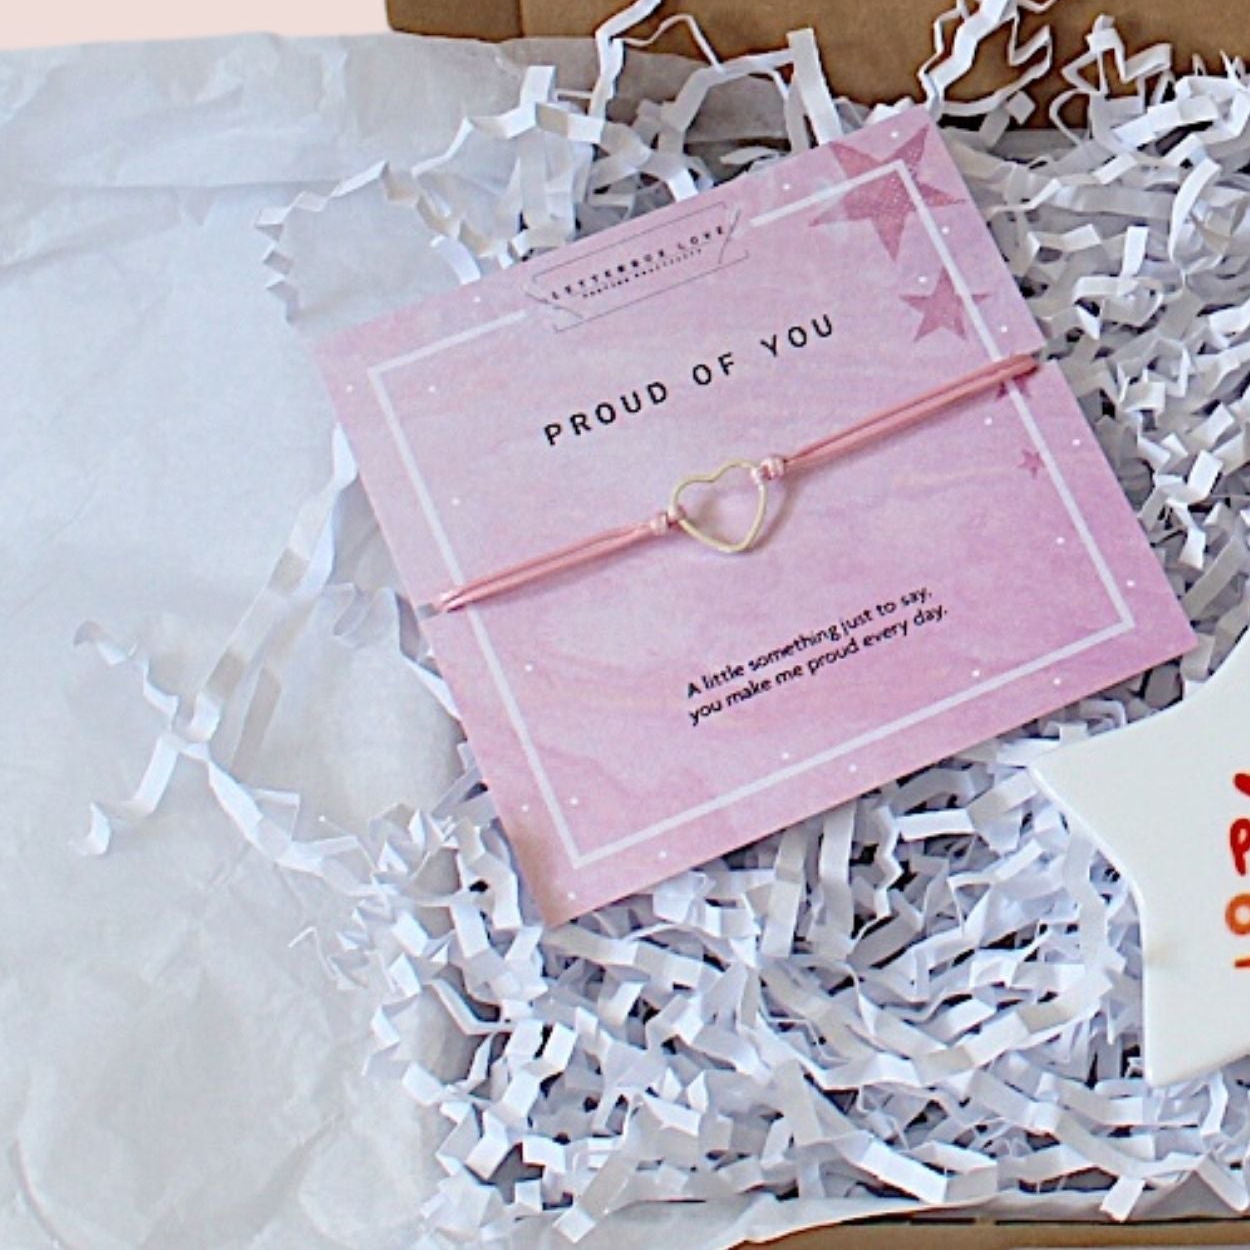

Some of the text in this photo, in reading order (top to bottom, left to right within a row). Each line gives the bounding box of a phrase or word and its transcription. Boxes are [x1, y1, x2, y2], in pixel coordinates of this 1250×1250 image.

[543, 314, 833, 446] PROUD OF YOU
[687, 682, 701, 698] A
[702, 664, 744, 690] little
[749, 624, 842, 671] something
[841, 608, 872, 637] just
[876, 601, 897, 617] to
[689, 701, 722, 726] you
[725, 680, 772, 707] make
[775, 665, 803, 685] me
[807, 638, 860, 676] proud
[862, 619, 909, 648] every
